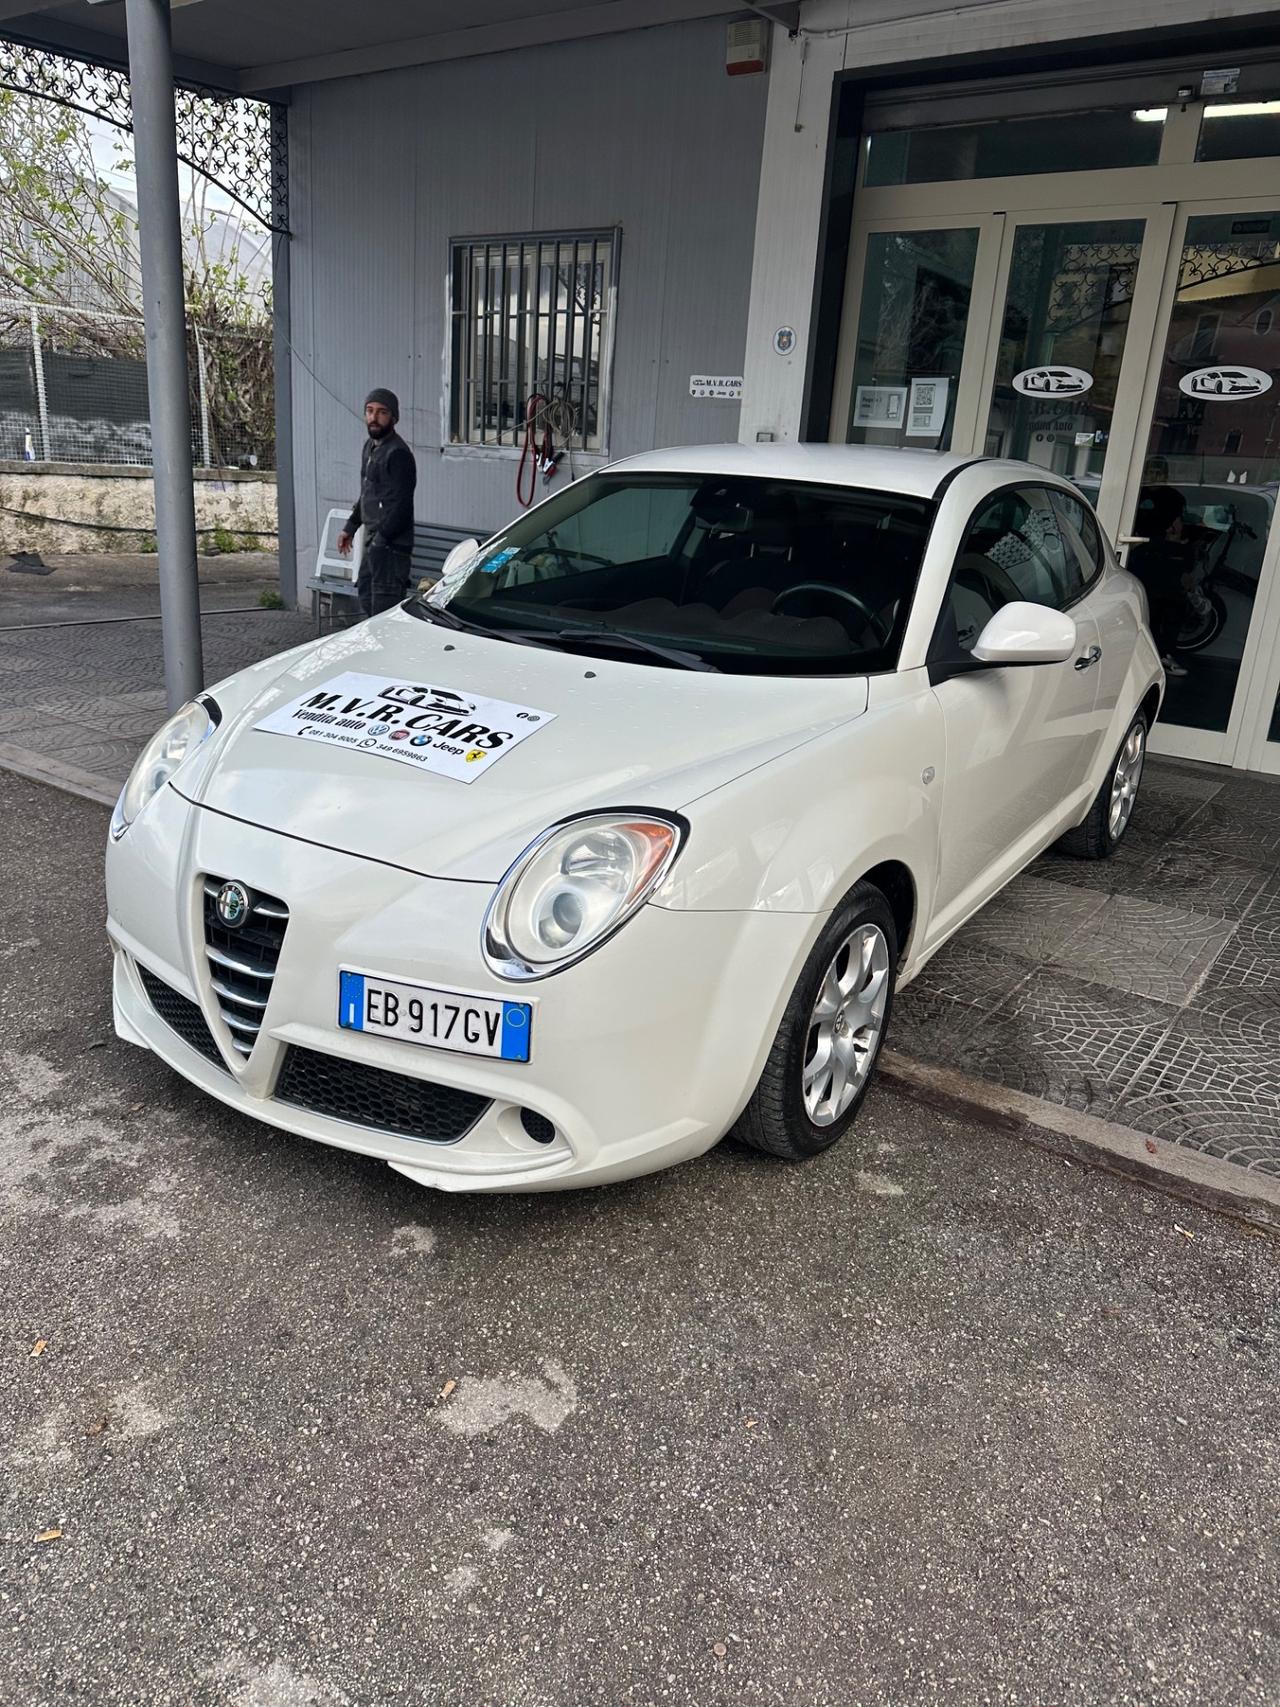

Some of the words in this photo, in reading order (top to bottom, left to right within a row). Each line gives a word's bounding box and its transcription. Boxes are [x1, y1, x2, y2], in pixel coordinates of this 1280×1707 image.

[292, 709, 338, 724] Vendita
[334, 719, 367, 730] auto
[433, 742, 465, 755] Jeep
[366, 988, 399, 1027] EB
[408, 998, 501, 1047] 917GV
